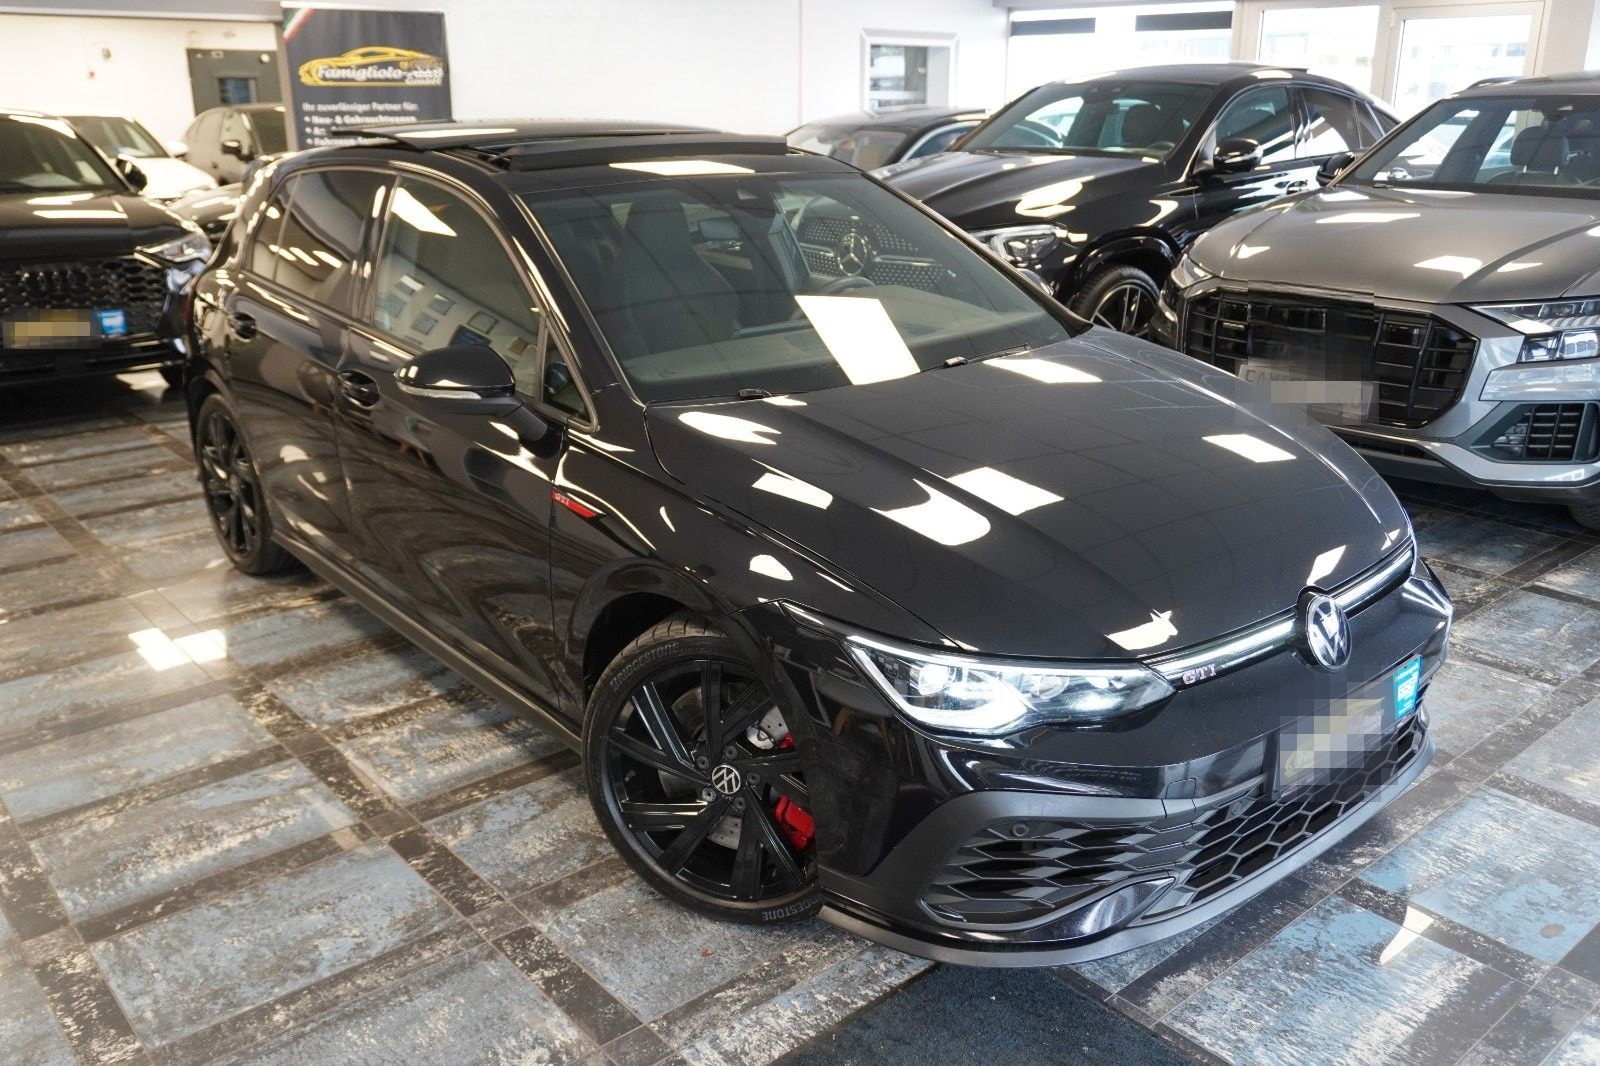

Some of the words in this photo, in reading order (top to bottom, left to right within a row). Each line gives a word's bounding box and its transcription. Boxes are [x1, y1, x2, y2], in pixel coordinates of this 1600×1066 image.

[302, 102, 315, 112] Ihr
[371, 102, 401, 112] Partner
[1182, 663, 1217, 685] GTI
